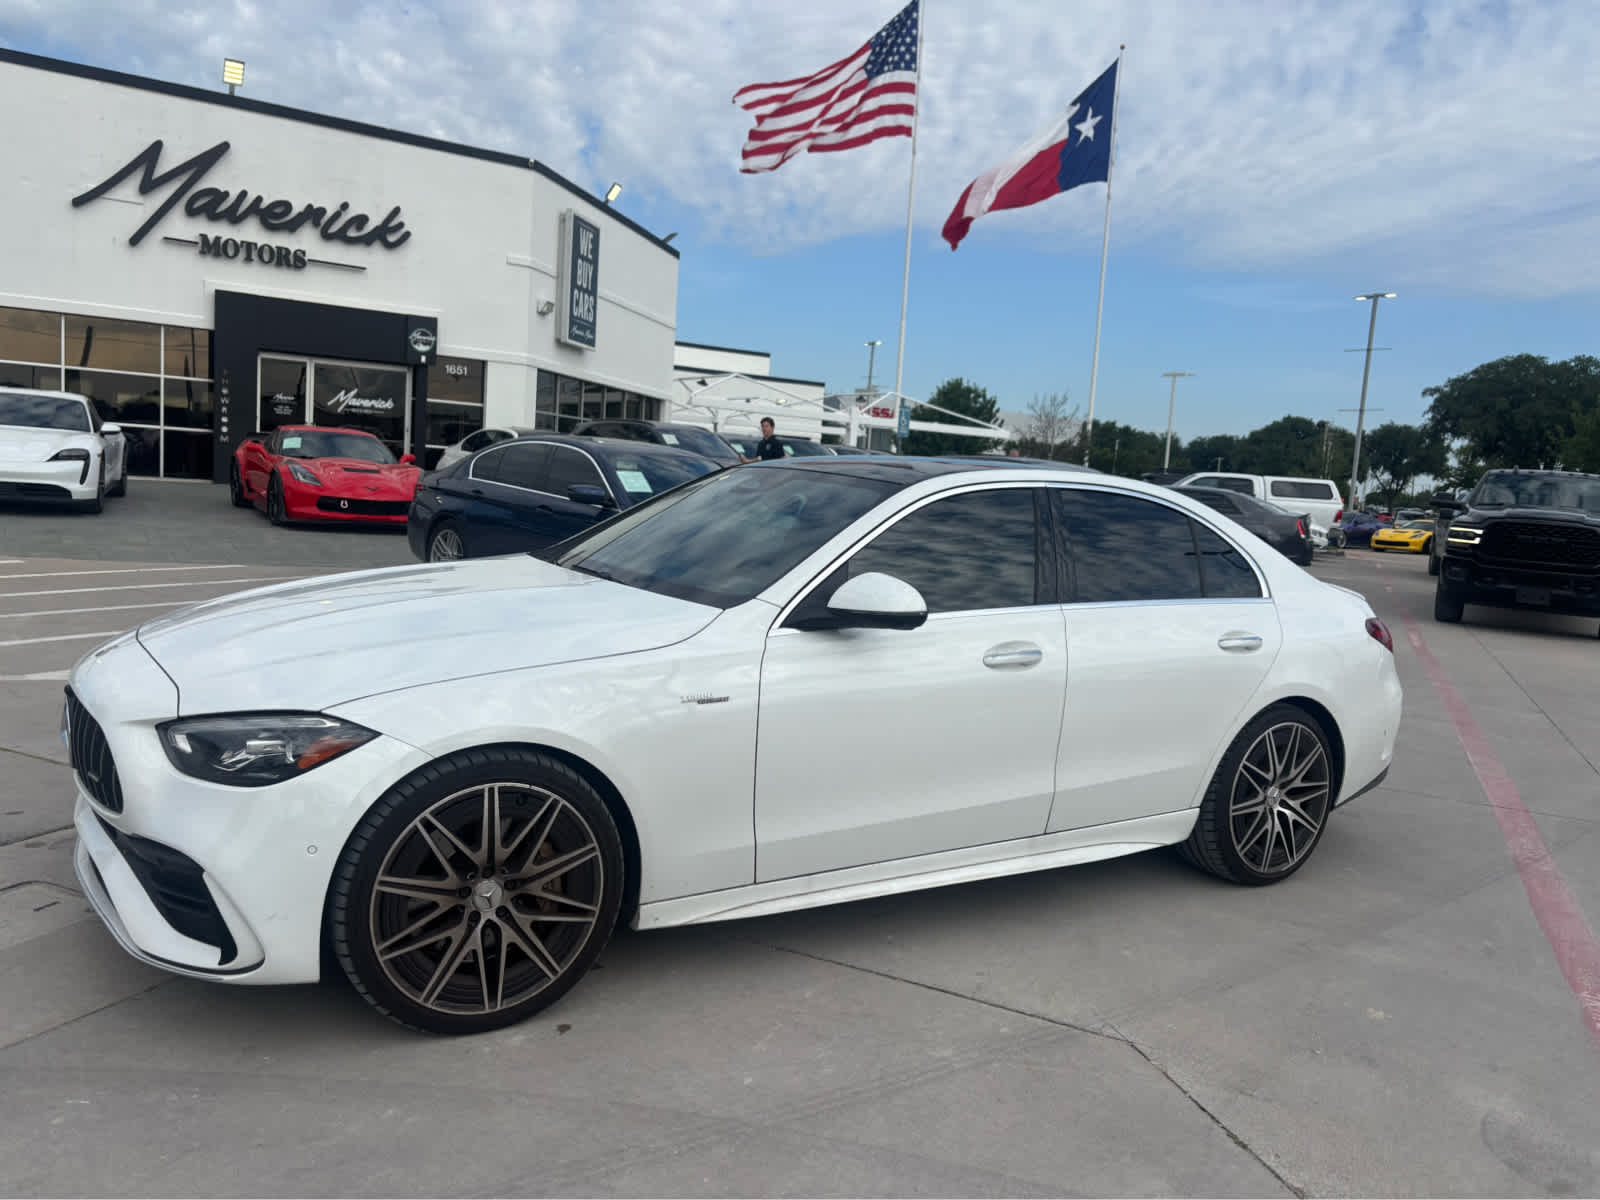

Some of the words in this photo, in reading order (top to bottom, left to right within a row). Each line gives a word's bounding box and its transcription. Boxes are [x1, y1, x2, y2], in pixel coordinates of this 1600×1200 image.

[72, 139, 411, 249] Maverick
[199, 233, 307, 270] MOTORS
[580, 229, 593, 258] WE
[577, 259, 593, 290] BUY
[573, 288, 594, 322] CARS
[445, 364, 468, 376] 1651
[327, 388, 394, 413] Maverick
